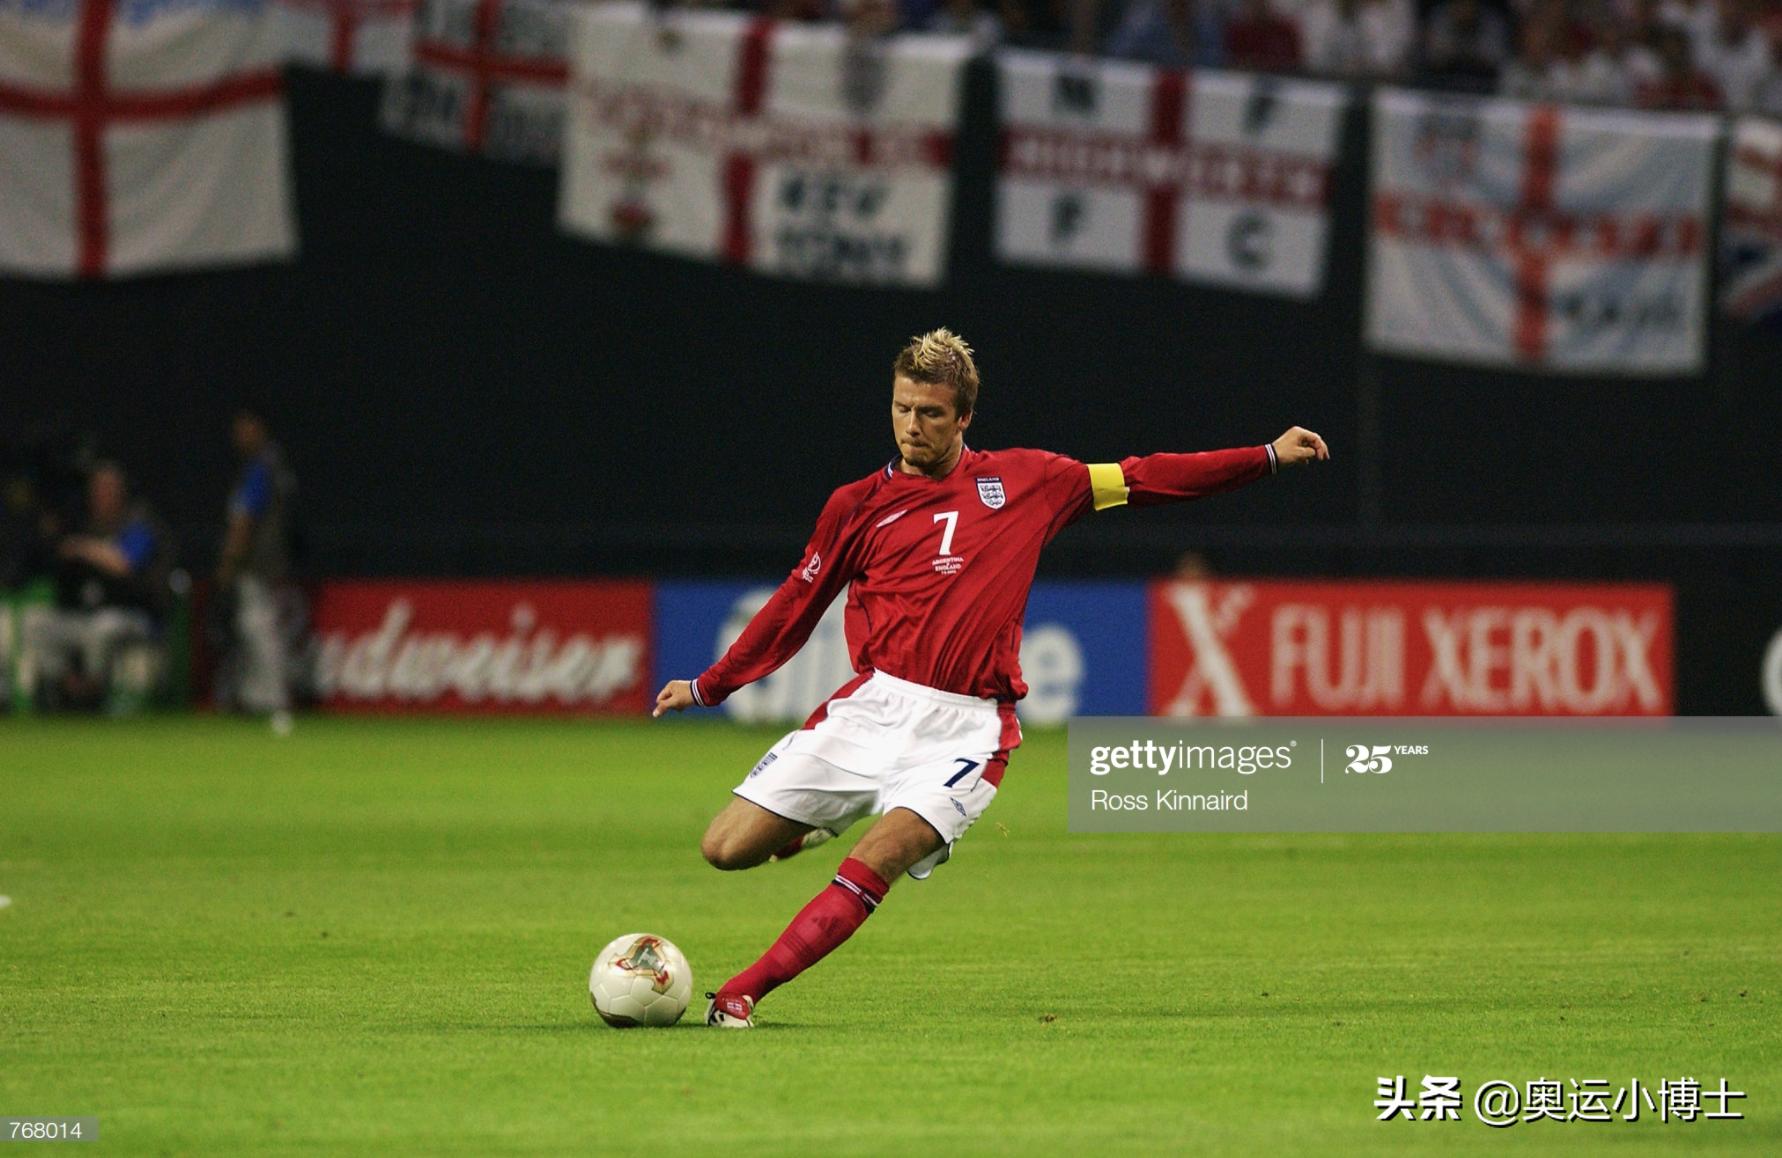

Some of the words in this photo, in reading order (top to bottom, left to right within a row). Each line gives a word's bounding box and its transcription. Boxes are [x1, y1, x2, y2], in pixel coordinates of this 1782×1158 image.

[933, 511, 959, 556] 7
[1270, 603, 1404, 709] FUJI
[1421, 605, 1662, 712] XEROX
[943, 757, 980, 788] 7
